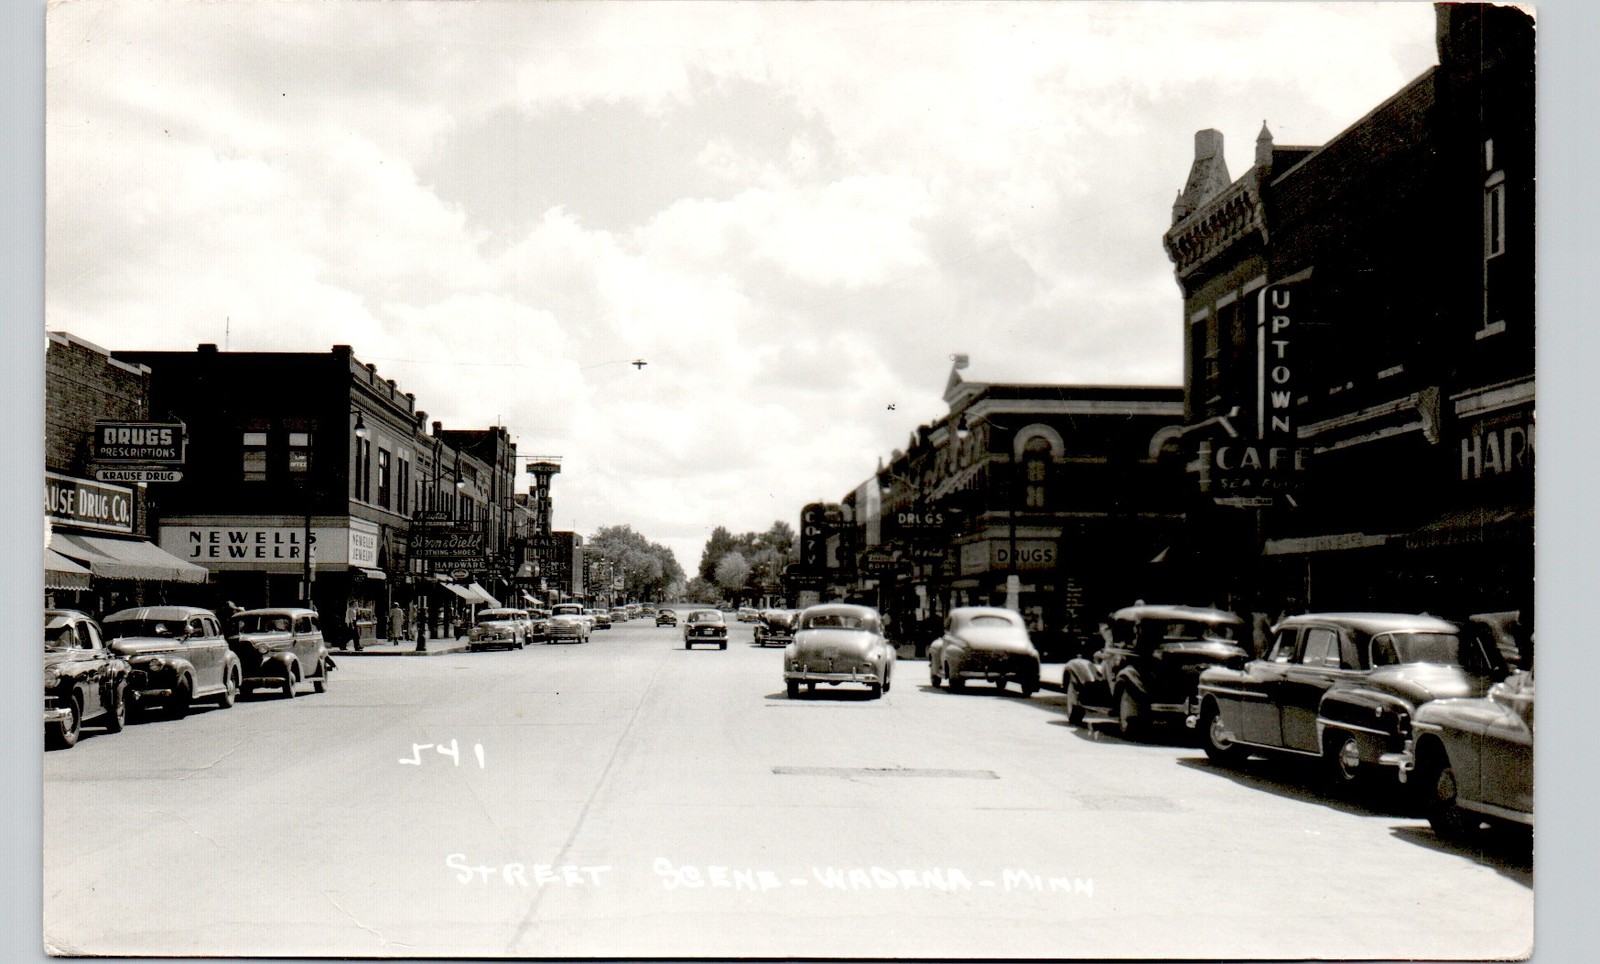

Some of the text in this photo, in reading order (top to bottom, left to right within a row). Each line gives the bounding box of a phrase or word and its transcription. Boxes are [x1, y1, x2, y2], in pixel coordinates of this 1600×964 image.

[1271, 290, 1291, 432] UPTOWN
[104, 428, 172, 445] DRUGS
[101, 447, 176, 458] PRESCRIPTIONS
[1216, 446, 1310, 470] CAFE
[103, 472, 174, 481] KRAUSE DRUG
[80, 489, 108, 520] DRUG
[190, 531, 317, 544] NEWELLS
[527, 538, 558, 547] MEALS
[190, 545, 317, 558] JEWELR
[997, 548, 1053, 563] DRUGS
[435, 561, 486, 569] HARDWARE
